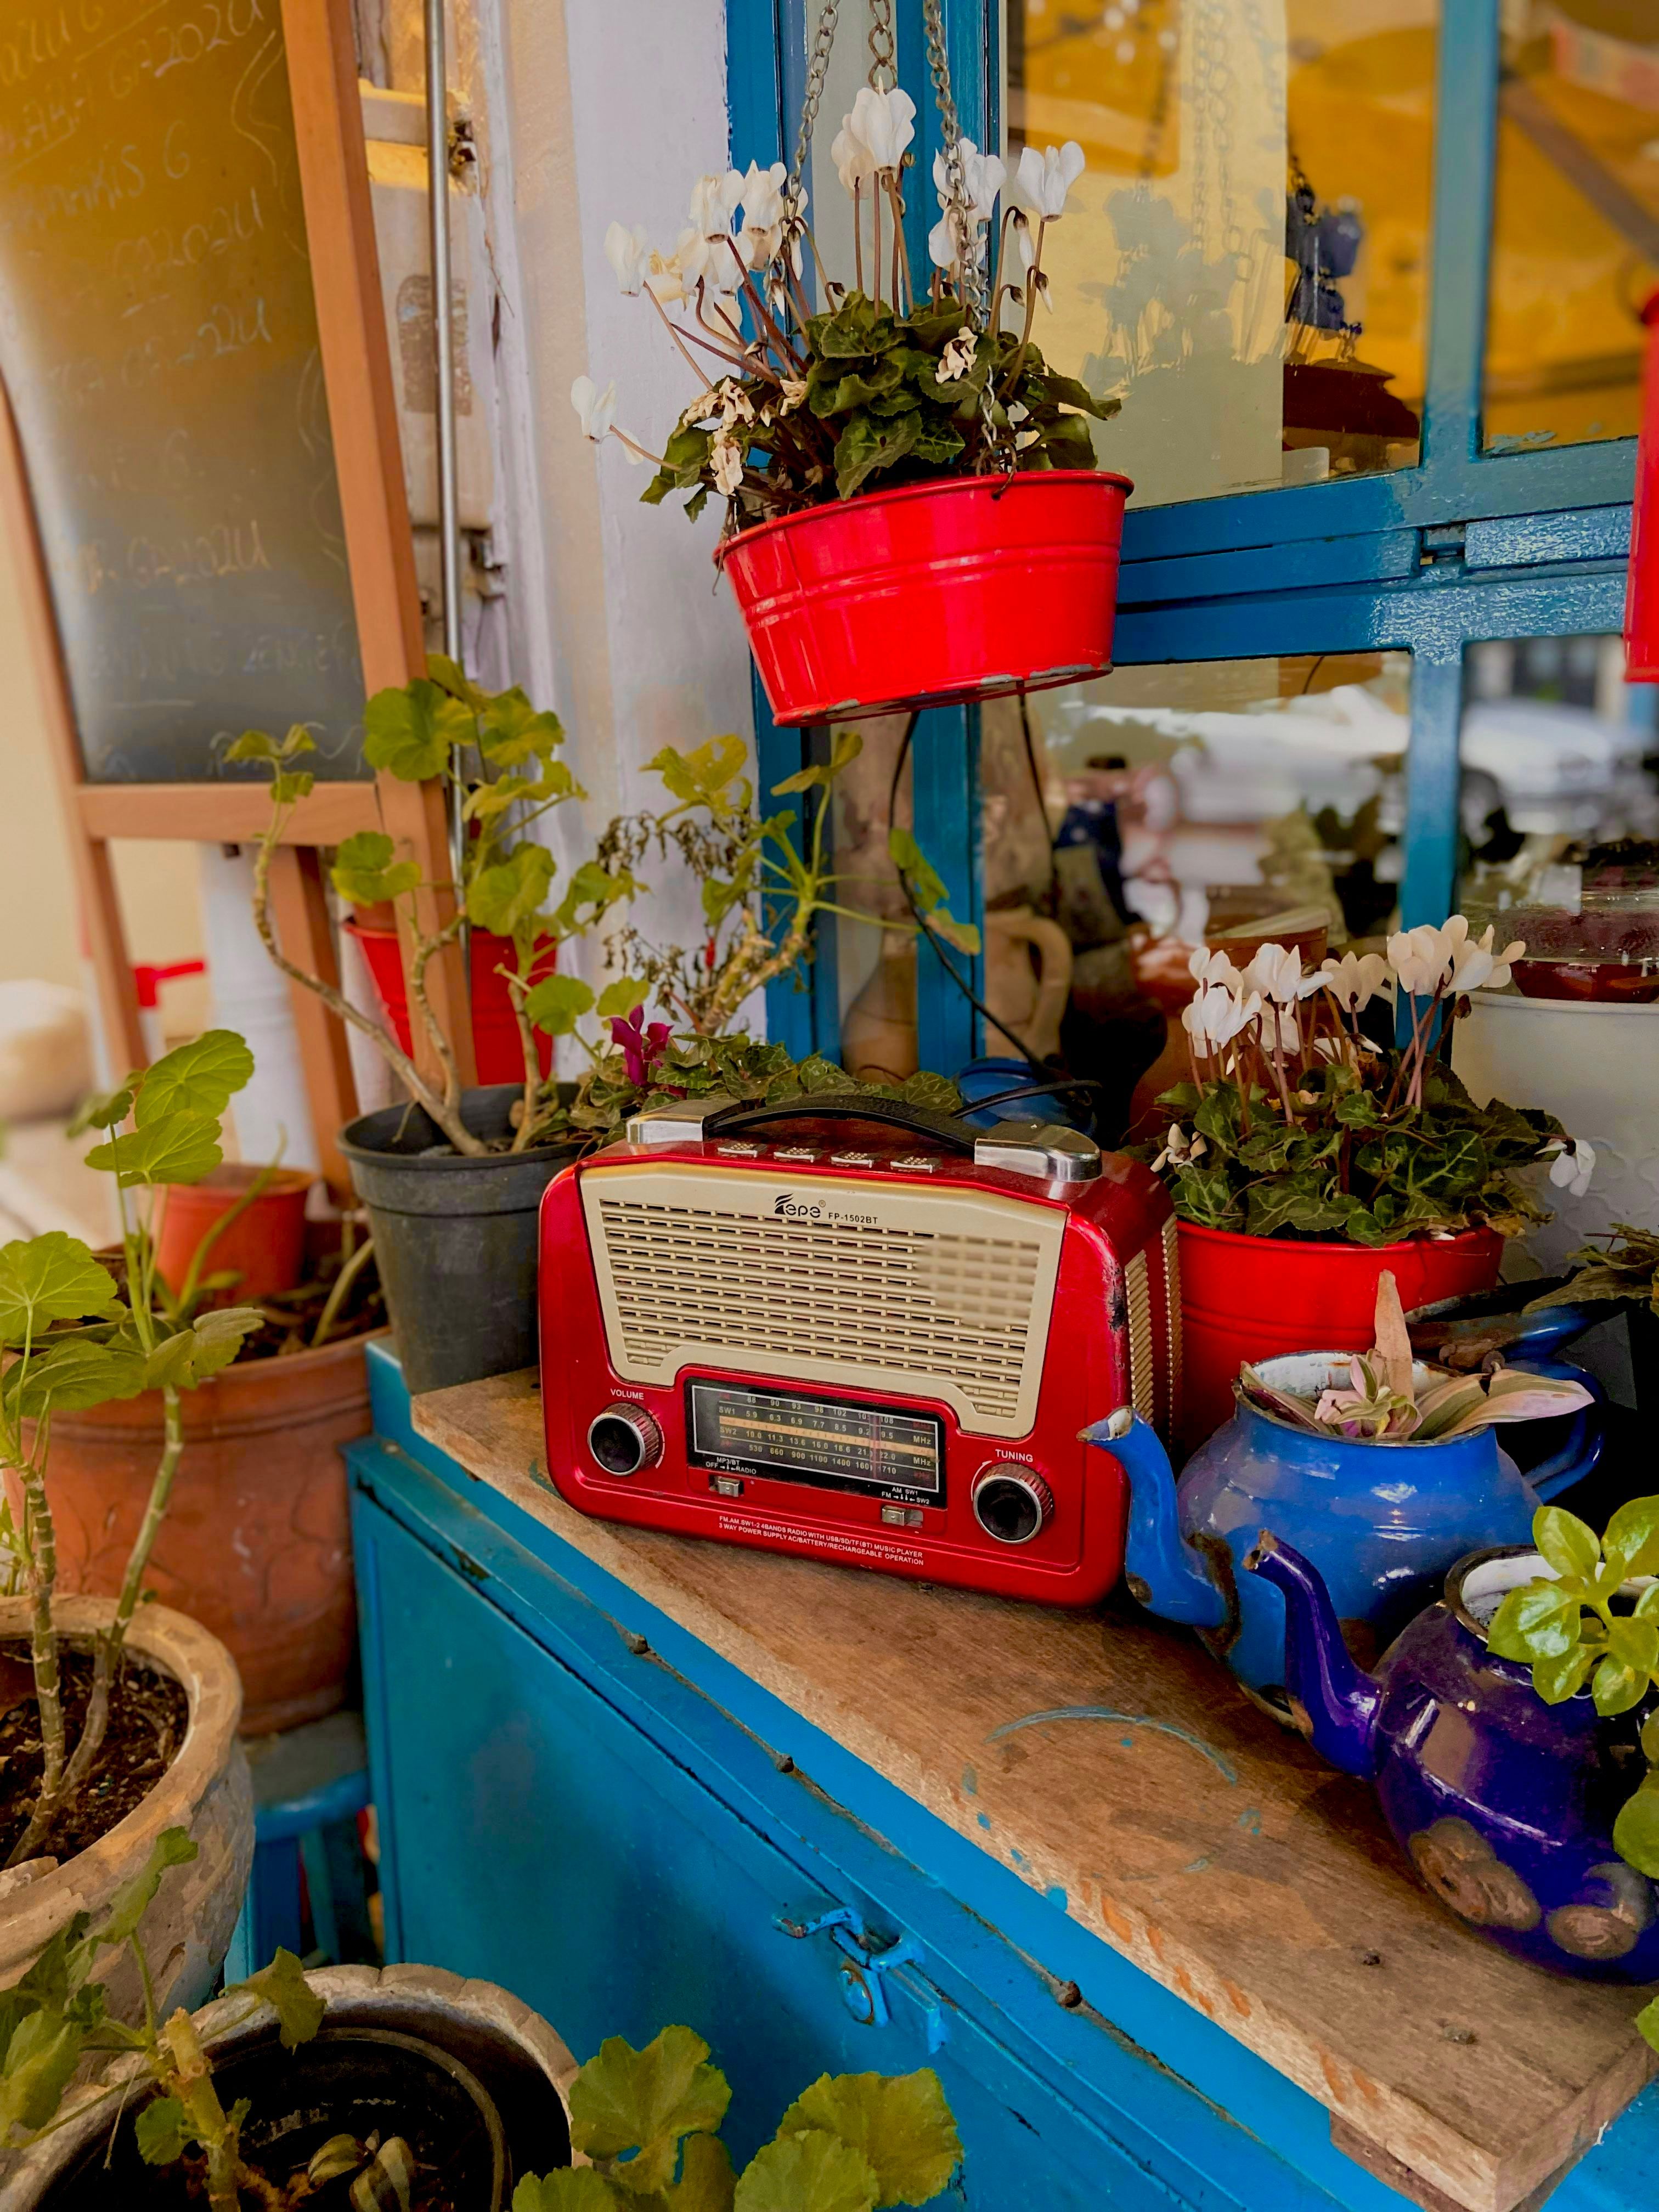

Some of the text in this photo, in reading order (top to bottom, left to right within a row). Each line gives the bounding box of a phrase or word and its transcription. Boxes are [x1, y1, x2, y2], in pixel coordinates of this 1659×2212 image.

[828, 1212, 878, 1224] FP-1502BT
[610, 1387, 645, 1400] VOLUME
[833, 1408, 847, 1417] 102
[719, 1406, 735, 1415] SW1
[834, 1424, 847, 1432] 8.5
[881, 1431, 893, 1439] 9.5
[913, 1435, 931, 1445] MHz
[720, 1426, 737, 1435] SW2
[913, 1457, 931, 1466] MHz
[716, 1457, 740, 1465] MP3/BT
[749, 1444, 763, 1452] 530
[770, 1447, 783, 1455] 660
[792, 1451, 805, 1459] 900
[810, 1454, 828, 1463] 1100
[832, 1458, 850, 1467] 1400
[995, 1448, 1034, 1463] TUNING
[736, 1465, 757, 1475] RADIO
[916, 1497, 930, 1505] SW2
[738, 1526, 762, 1536] POWER
[763, 1530, 787, 1541] SUPPLY
[787, 1535, 882, 1558] AC/BATTERY/RECHARGEABLE
[884, 1553, 924, 1566] OPERATION
[761, 1523, 786, 1533] 4BANDS
[787, 1527, 808, 1537] RADIO
[826, 1535, 873, 1549] USB/SD/TF(BT)
[874, 1544, 896, 1553] MUSIC
[896, 1548, 923, 1558] PLAYER
